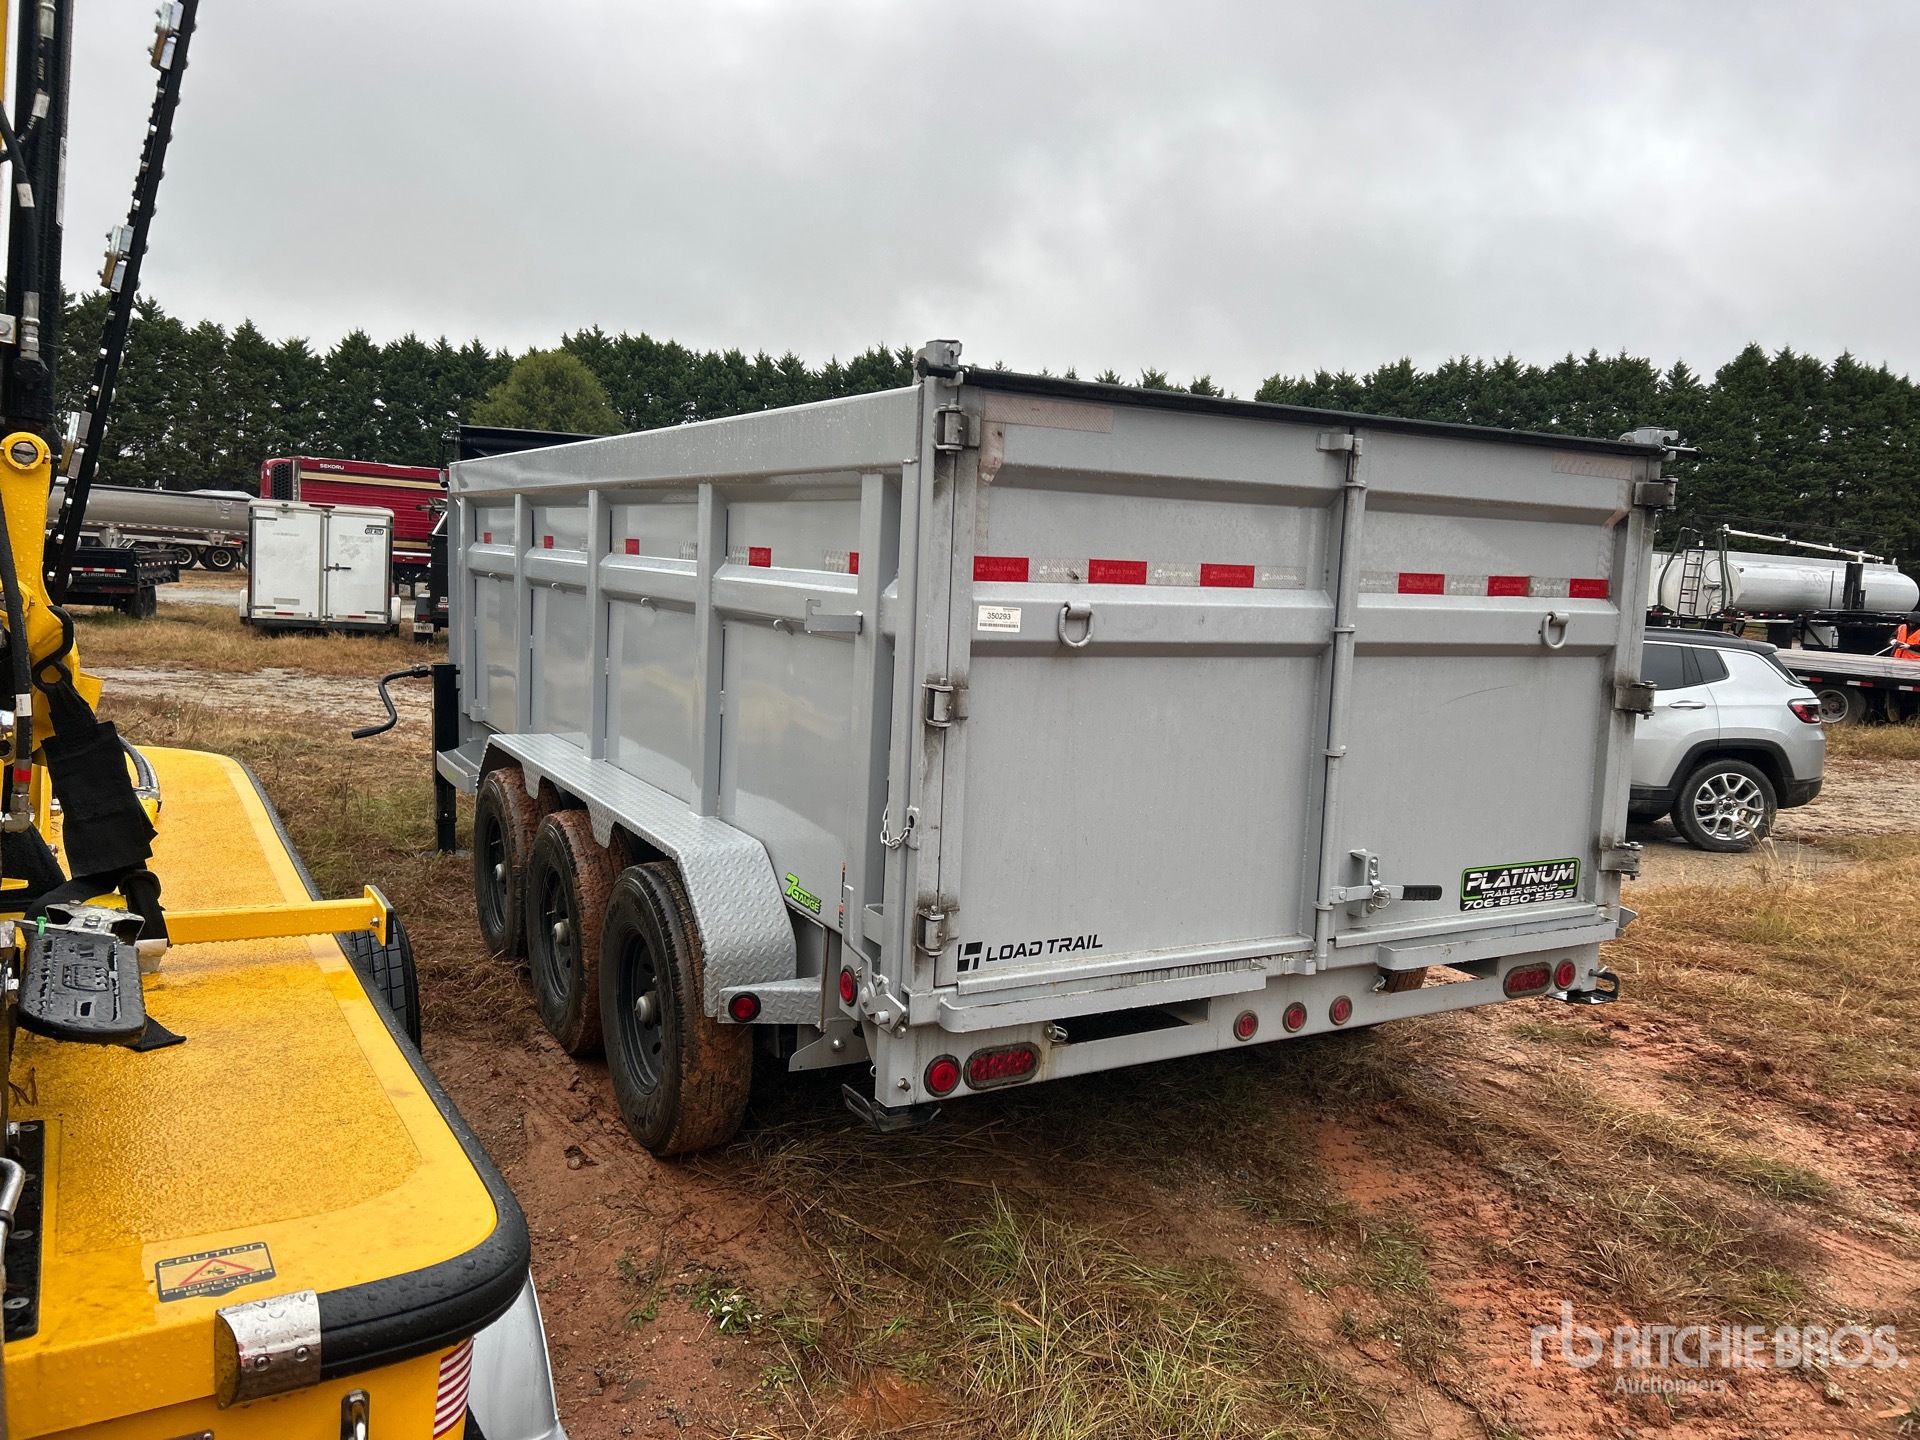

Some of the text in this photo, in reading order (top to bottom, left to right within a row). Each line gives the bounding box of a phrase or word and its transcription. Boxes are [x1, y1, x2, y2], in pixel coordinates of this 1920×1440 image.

[987, 612, 1011, 621] 350293
[1466, 862, 1575, 891] PLATINUM
[791, 885, 821, 914] GAUGE
[1464, 889, 1574, 910] 706-850-5593
[1481, 883, 1559, 899] TRAILER GROUP
[159, 1243, 265, 1267] CAUTION
[162, 1268, 273, 1296] PROPELLER
[185, 1278, 253, 1297] BELOW
